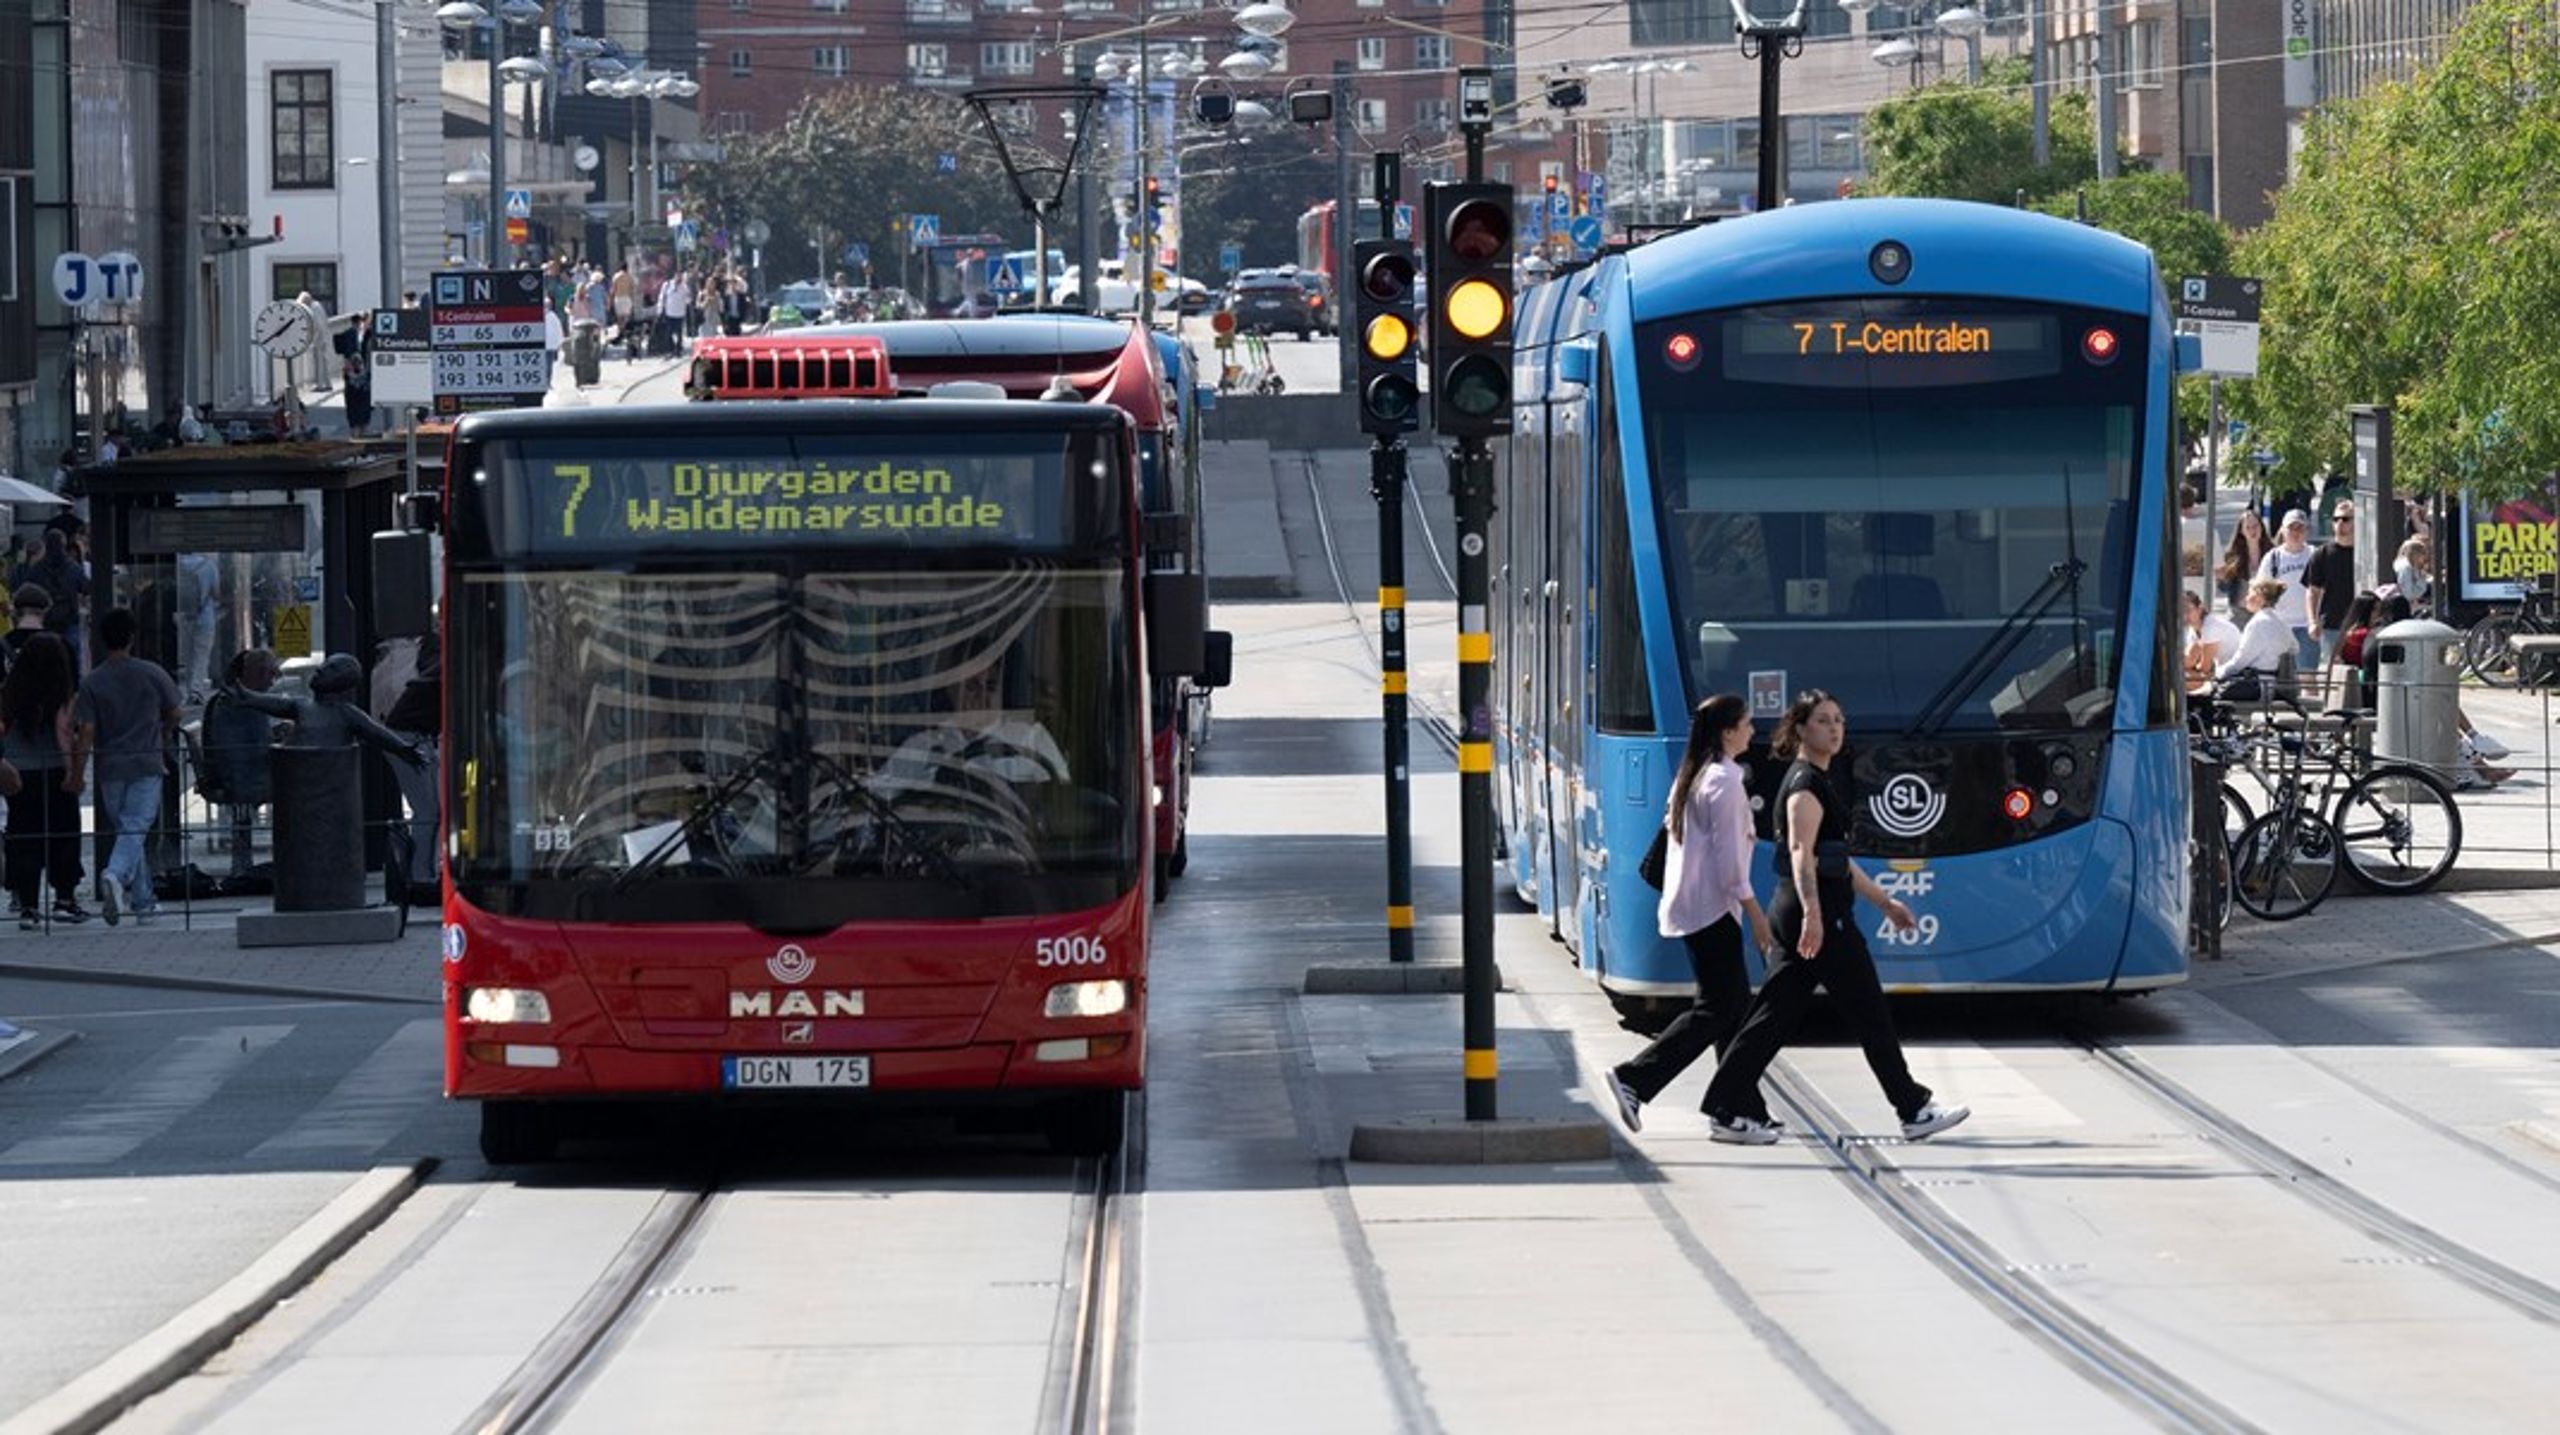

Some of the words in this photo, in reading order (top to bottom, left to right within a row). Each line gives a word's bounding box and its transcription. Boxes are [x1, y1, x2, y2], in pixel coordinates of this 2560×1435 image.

[1554, 195, 1567, 214] P
[64, 260, 87, 301] J
[473, 279, 491, 300] N
[437, 327, 456, 340] 54
[475, 327, 494, 340] 65
[511, 325, 532, 339] 69
[1793, 323, 1815, 354] 7
[1830, 321, 1990, 354] T-Centralen
[438, 353, 465, 368] 190
[475, 353, 502, 367] 191
[513, 351, 541, 366] 192
[439, 373, 466, 386] 193
[476, 372, 504, 386] 194
[513, 370, 542, 384] 195
[673, 462, 952, 498] Djurgården
[554, 465, 591, 536] 7
[626, 496, 1003, 531] Waldemarsudde
[2475, 520, 2557, 554] PARK
[1891, 785, 1925, 810] SL
[1037, 935, 1107, 967] 5006
[729, 989, 865, 1018] MAN
[740, 1061, 792, 1084] DGN
[815, 1060, 863, 1083] 175
